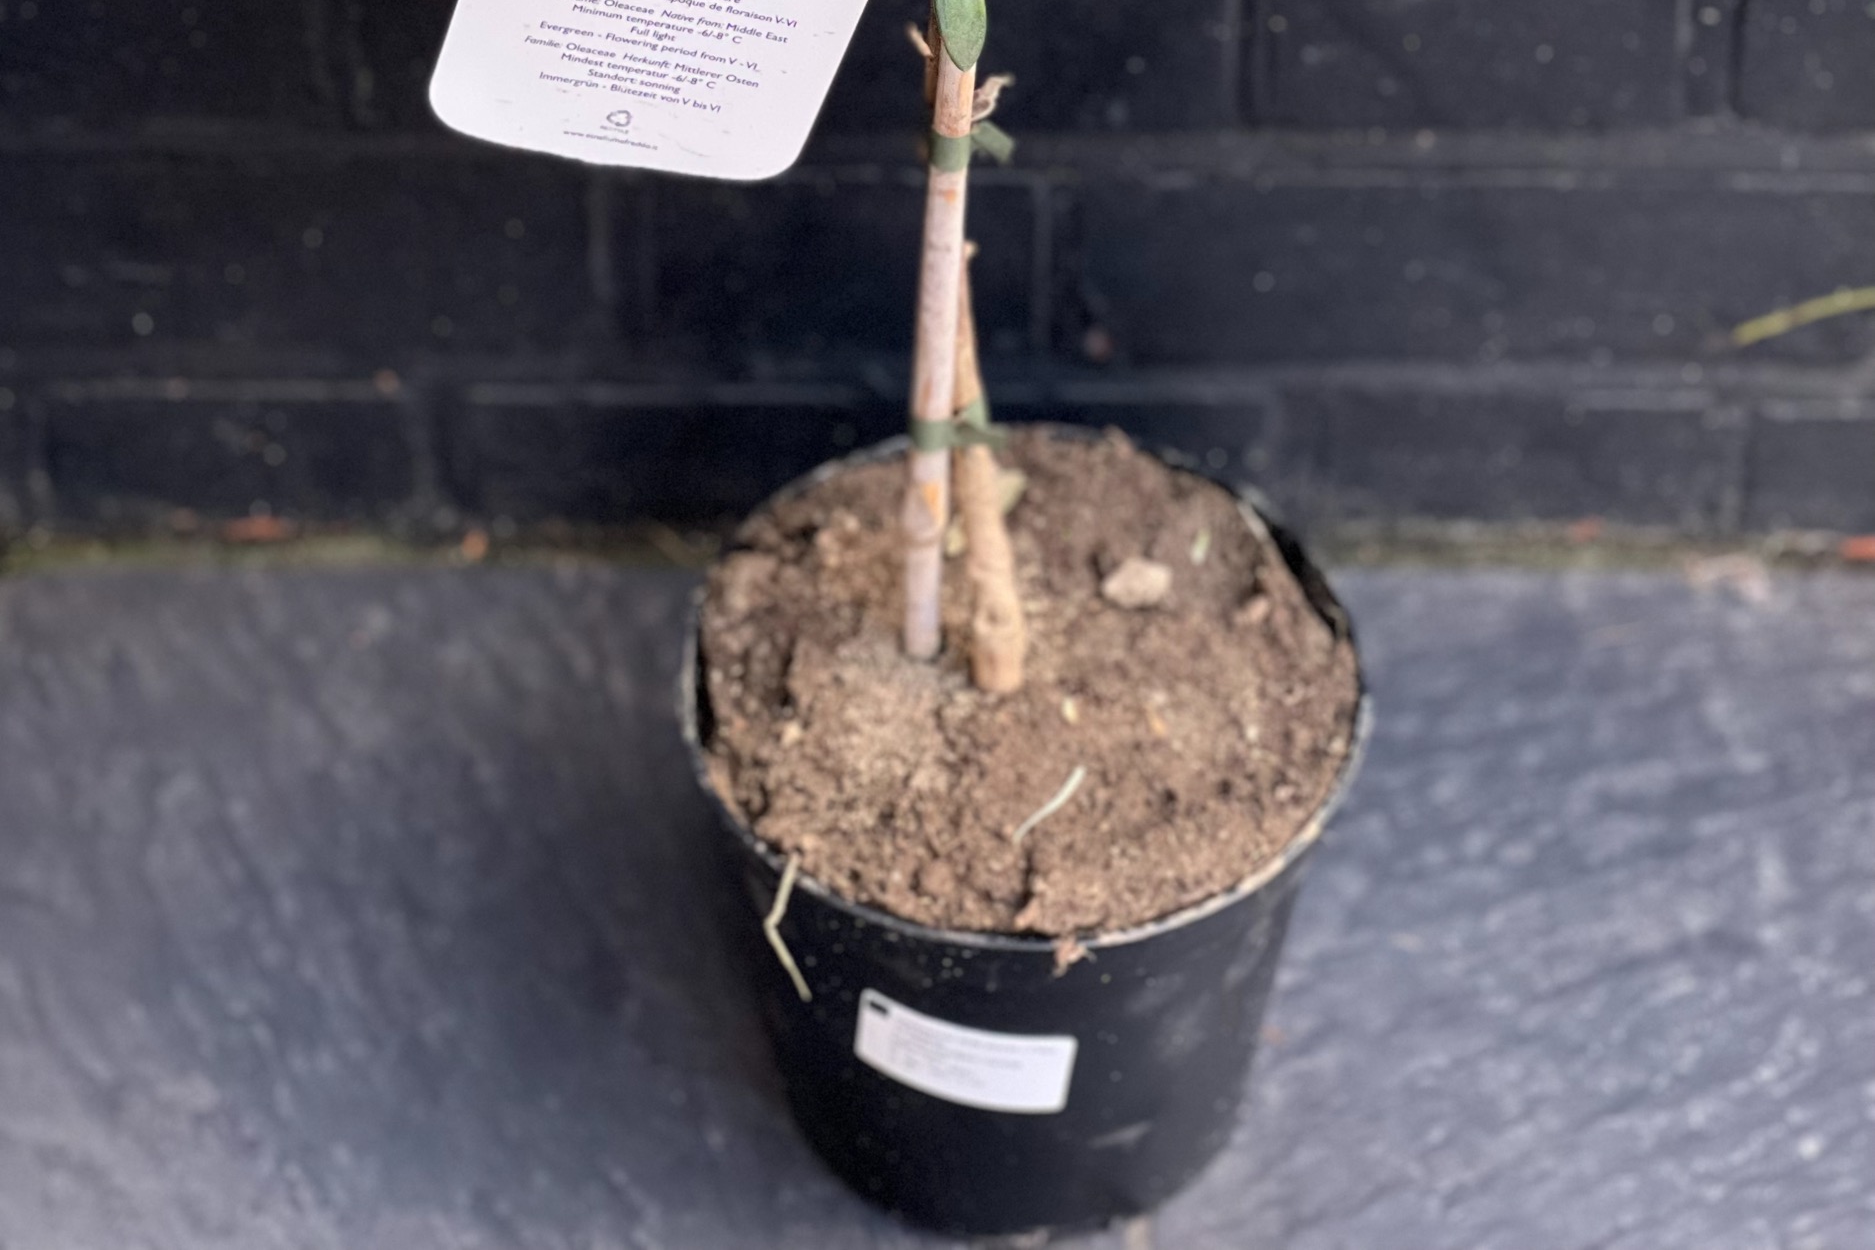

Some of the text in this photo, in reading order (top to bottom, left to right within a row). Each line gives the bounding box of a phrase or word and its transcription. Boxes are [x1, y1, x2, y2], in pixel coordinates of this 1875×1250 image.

[572, 4, 623, 20] Minimum
[626, 16, 694, 34] temperature
[732, 36, 742, 44] C
[604, 0, 655, 15] Oleaceae
[660, 10, 694, 23] Native
[726, 23, 762, 37] Middle
[766, 32, 788, 43] East
[709, 3, 722, 11] de
[725, 6, 773, 22] floraison
[540, 21, 594, 37] Evergreen
[605, 33, 659, 51] Flowering
[660, 45, 698, 57] period
[700, 51, 726, 64] from
[729, 57, 738, 65] V
[630, 26, 676, 42] Full light
[561, 53, 604, 67] Mindest
[607, 62, 669, 79] temperatur
[706, 81, 716, 89] C
[566, 42, 616, 58] Oleaceae
[674, 63, 723, 79] Mittlerer
[726, 74, 759, 88] Osten
[540, 72, 599, 88] Immergrün
[661, 95, 680, 103] von
[682, 97, 691, 105] V
[692, 100, 707, 110] bis
[710, 104, 721, 113] VI
